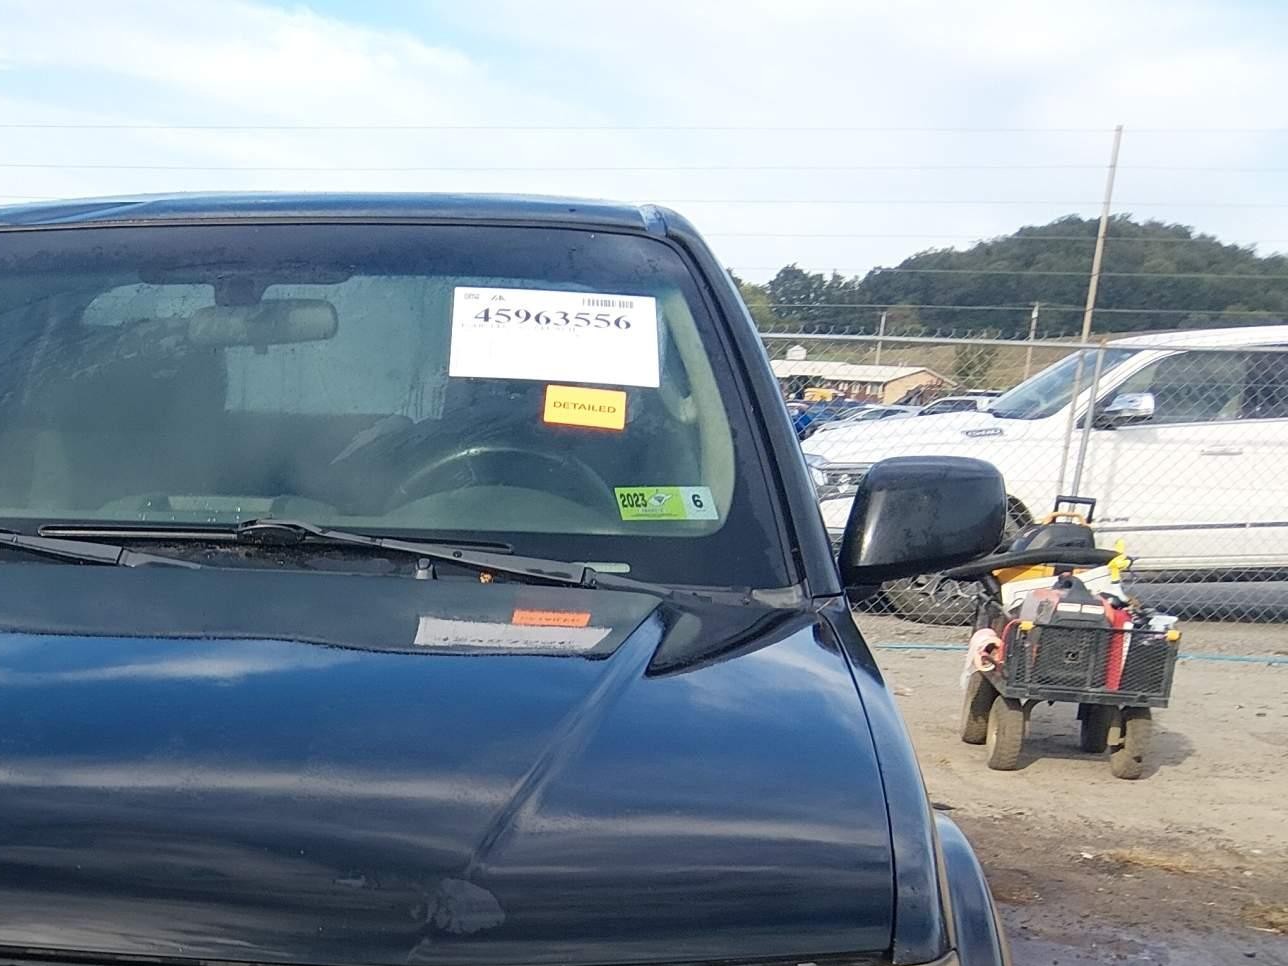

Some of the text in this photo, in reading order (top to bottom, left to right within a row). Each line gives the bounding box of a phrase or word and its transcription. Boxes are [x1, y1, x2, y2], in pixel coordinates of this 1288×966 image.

[474, 307, 632, 330] 45963556
[553, 400, 617, 414] DETAILED
[619, 492, 705, 509] 2023 6
